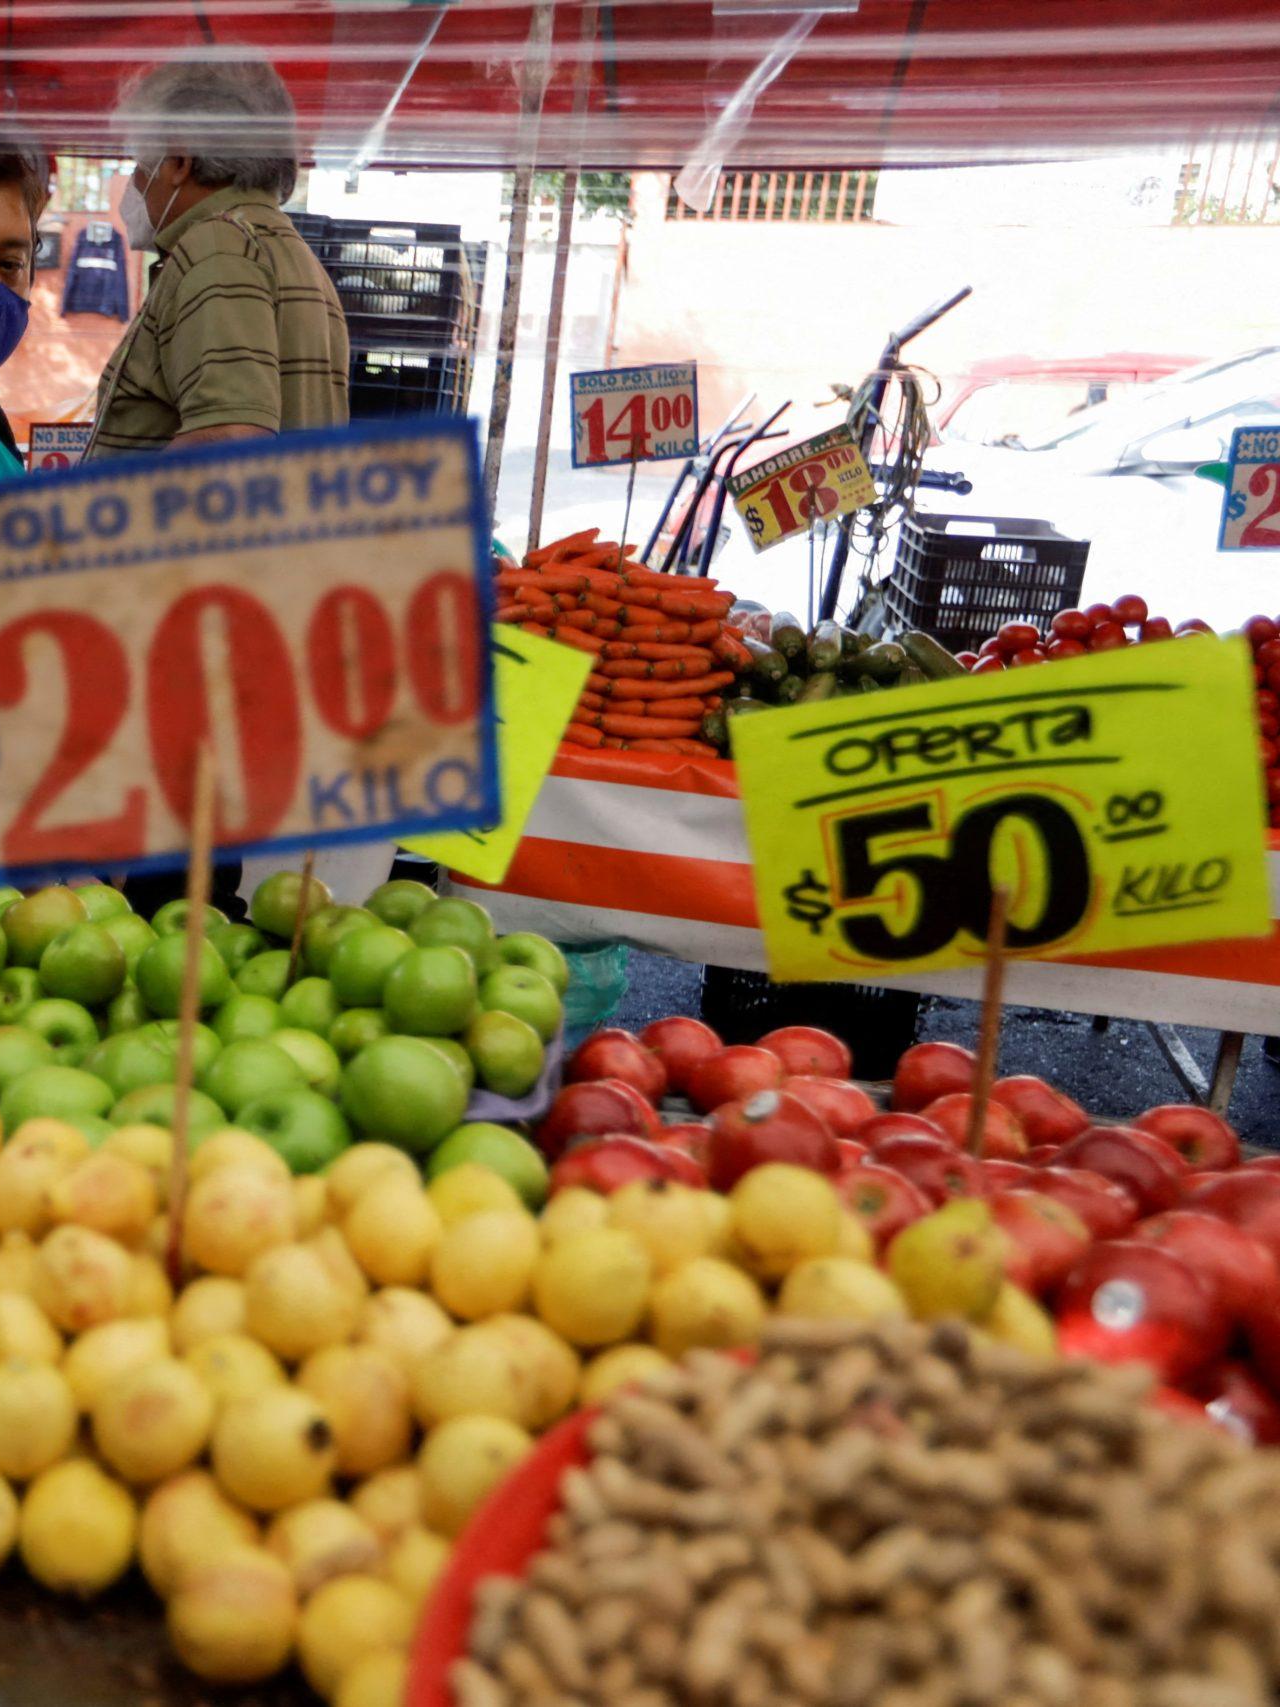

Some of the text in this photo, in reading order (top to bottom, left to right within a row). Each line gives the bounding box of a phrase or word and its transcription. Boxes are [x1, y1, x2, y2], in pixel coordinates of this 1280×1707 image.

[578, 375, 617, 388] SOLO
[657, 368, 688, 381] HOY
[35, 431, 54, 444] NO
[655, 438, 695, 457] KILO
[152, 476, 285, 532] POR
[306, 457, 447, 508] HOY
[308, 756, 482, 827] KILO
[1111, 857, 1232, 911] KILO
